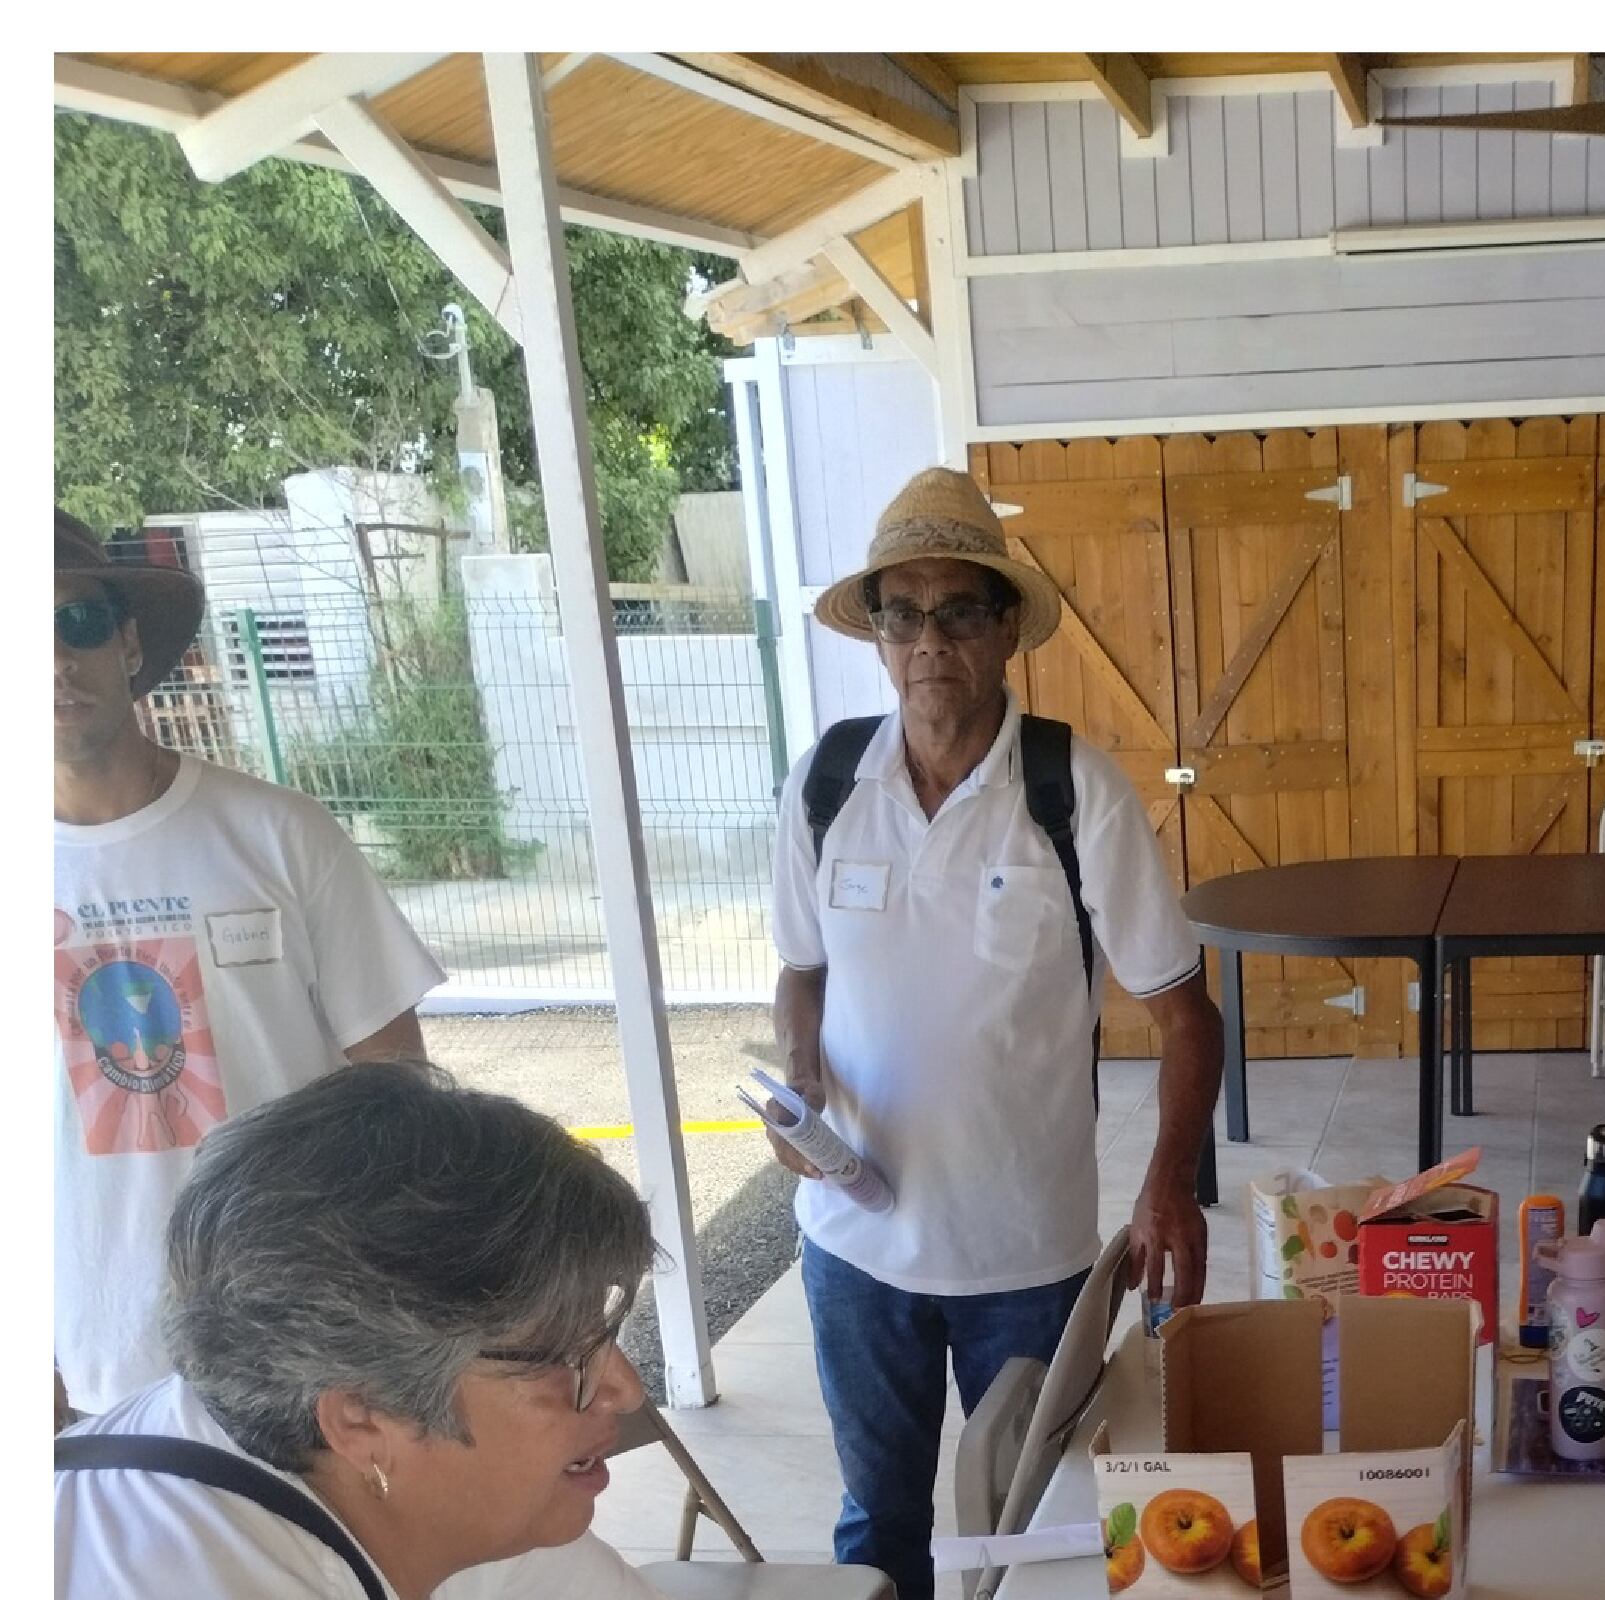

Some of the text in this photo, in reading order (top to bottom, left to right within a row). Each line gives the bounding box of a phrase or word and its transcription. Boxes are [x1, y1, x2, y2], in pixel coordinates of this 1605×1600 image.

[1382, 1251, 1475, 1270] CHEWY
[1383, 1273, 1474, 1290] PROTEIN
[1143, 1461, 1172, 1473] GAL
